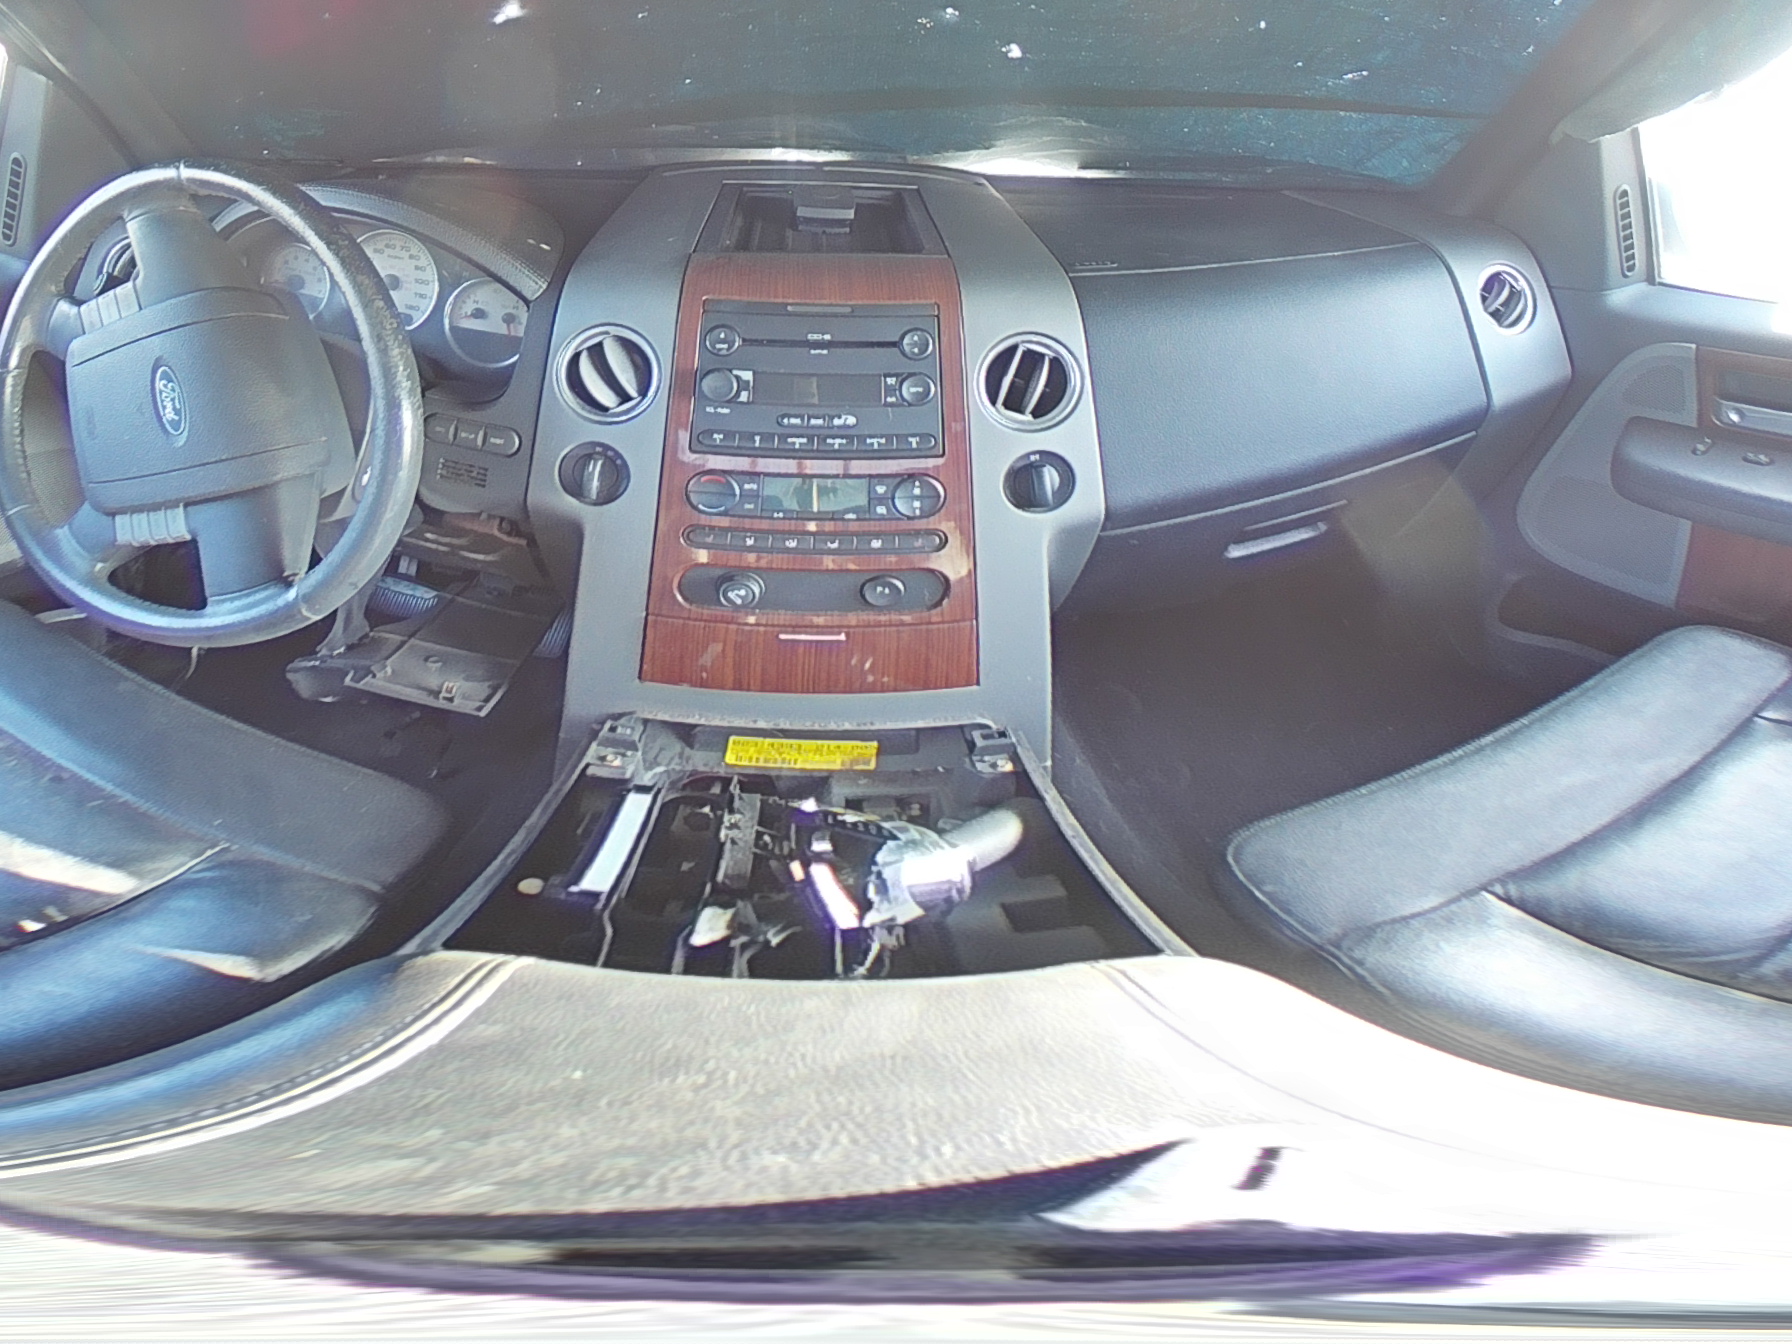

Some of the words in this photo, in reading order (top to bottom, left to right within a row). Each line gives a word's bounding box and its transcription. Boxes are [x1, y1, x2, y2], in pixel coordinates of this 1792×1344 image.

[414, 278, 430, 286] 100
[414, 292, 428, 300] 110
[159, 380, 181, 421] Ford
